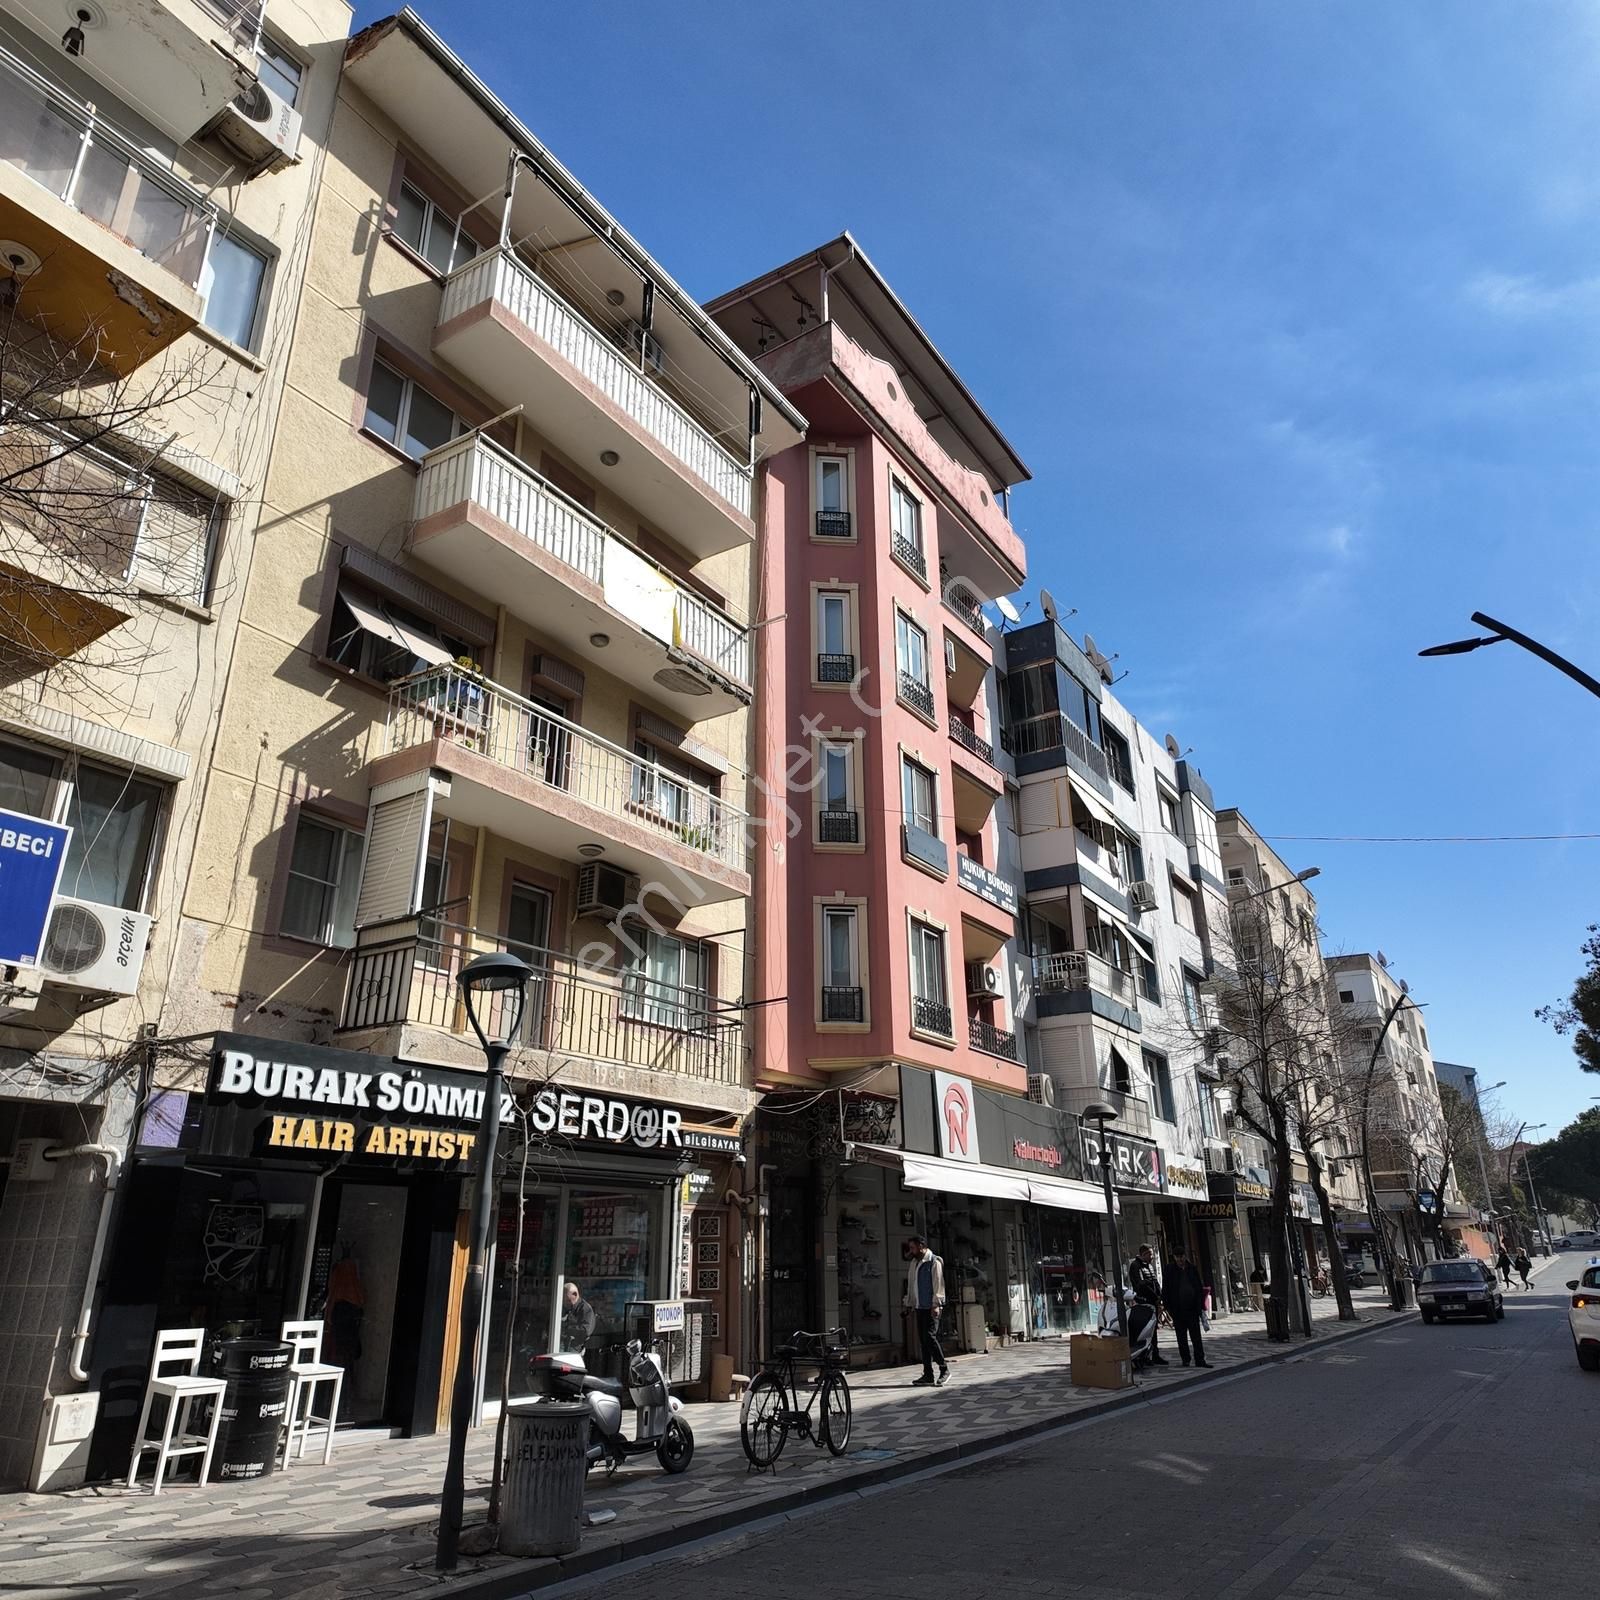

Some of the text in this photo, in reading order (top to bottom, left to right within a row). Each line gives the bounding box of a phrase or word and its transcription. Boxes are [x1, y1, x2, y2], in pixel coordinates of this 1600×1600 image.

[0, 828, 54, 858] BECİ
[961, 857, 987, 882] HUKUK
[116, 915, 136, 967] arçelik
[219, 1050, 373, 1108] BURAK
[268, 1115, 475, 1160] HAIR ARTIST
[685, 1133, 740, 1151] BİLGİSAYAR
[1191, 1203, 1234, 1217] ALLORA
